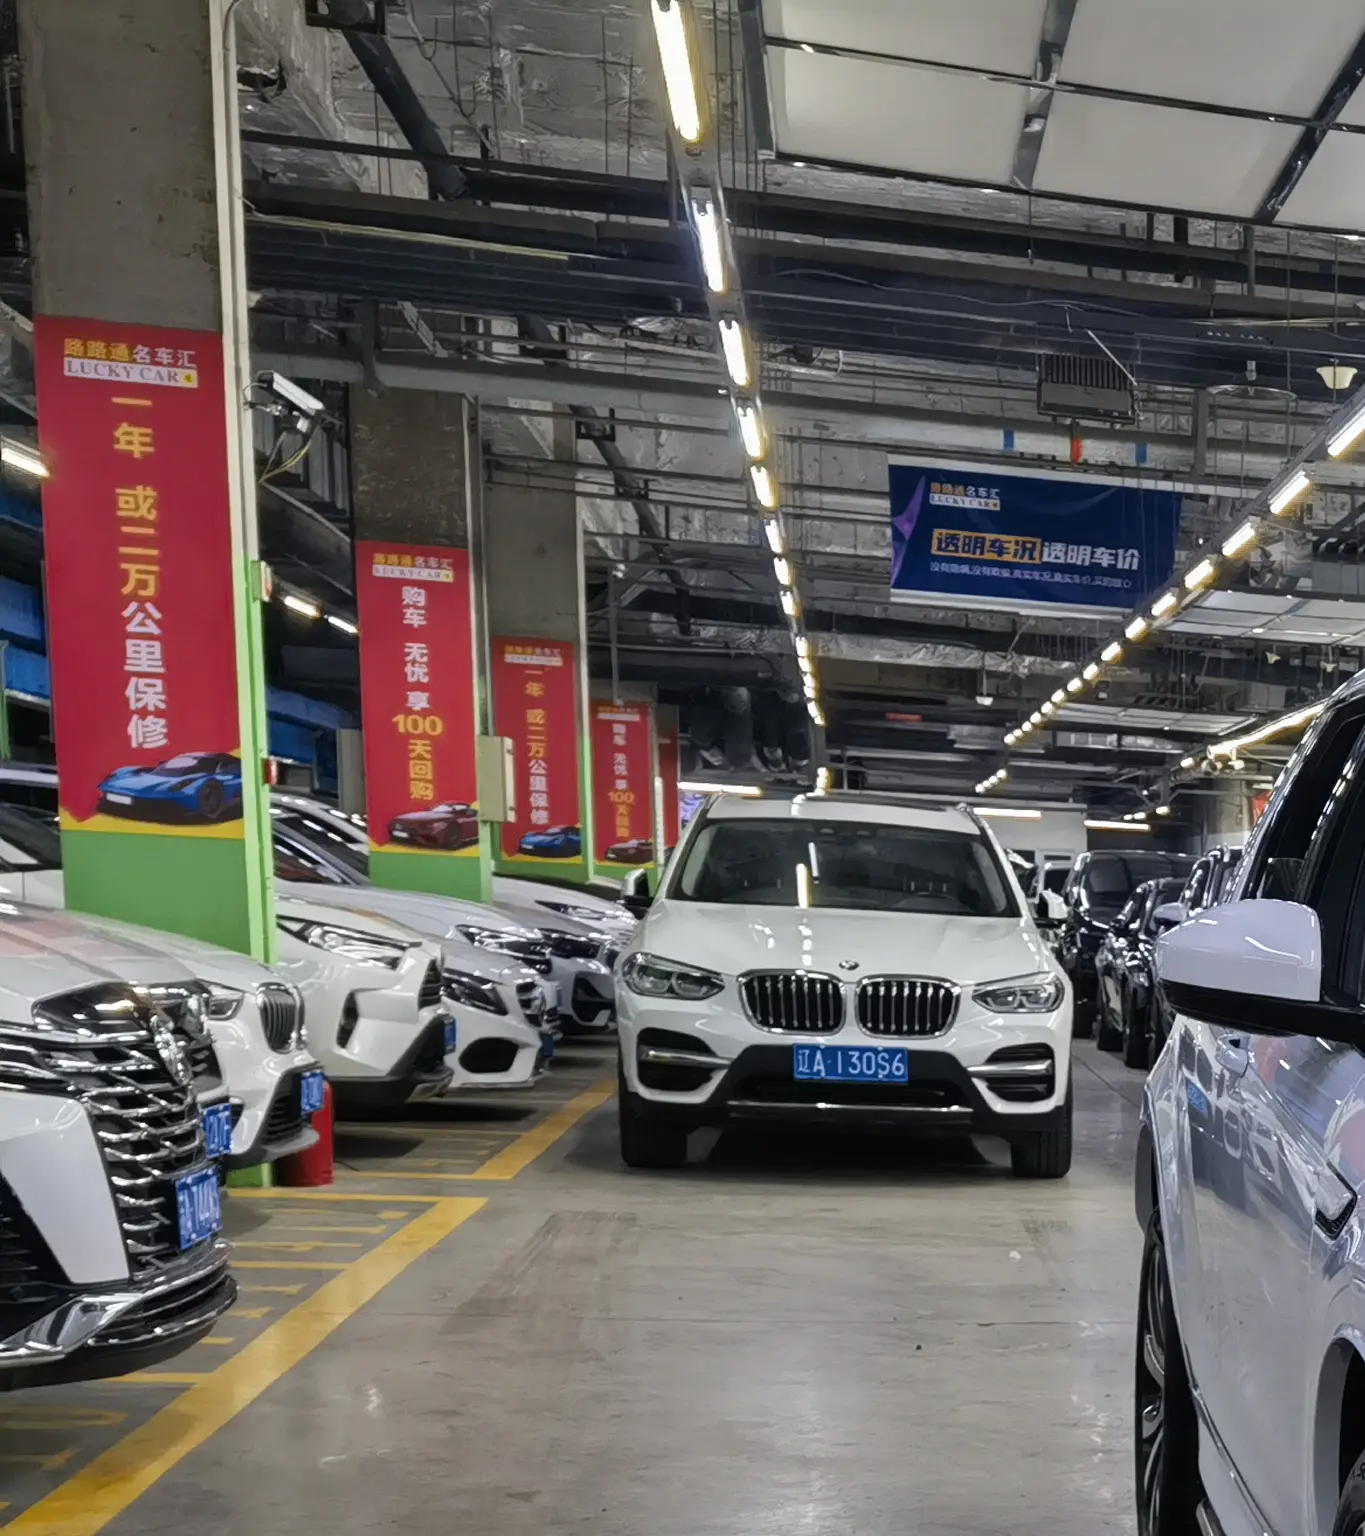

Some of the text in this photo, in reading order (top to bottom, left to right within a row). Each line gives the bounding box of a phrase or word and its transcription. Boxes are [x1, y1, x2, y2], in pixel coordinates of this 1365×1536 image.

[64, 338, 197, 367] 路路通名车汇
[66, 359, 180, 383] LUCKY CAR
